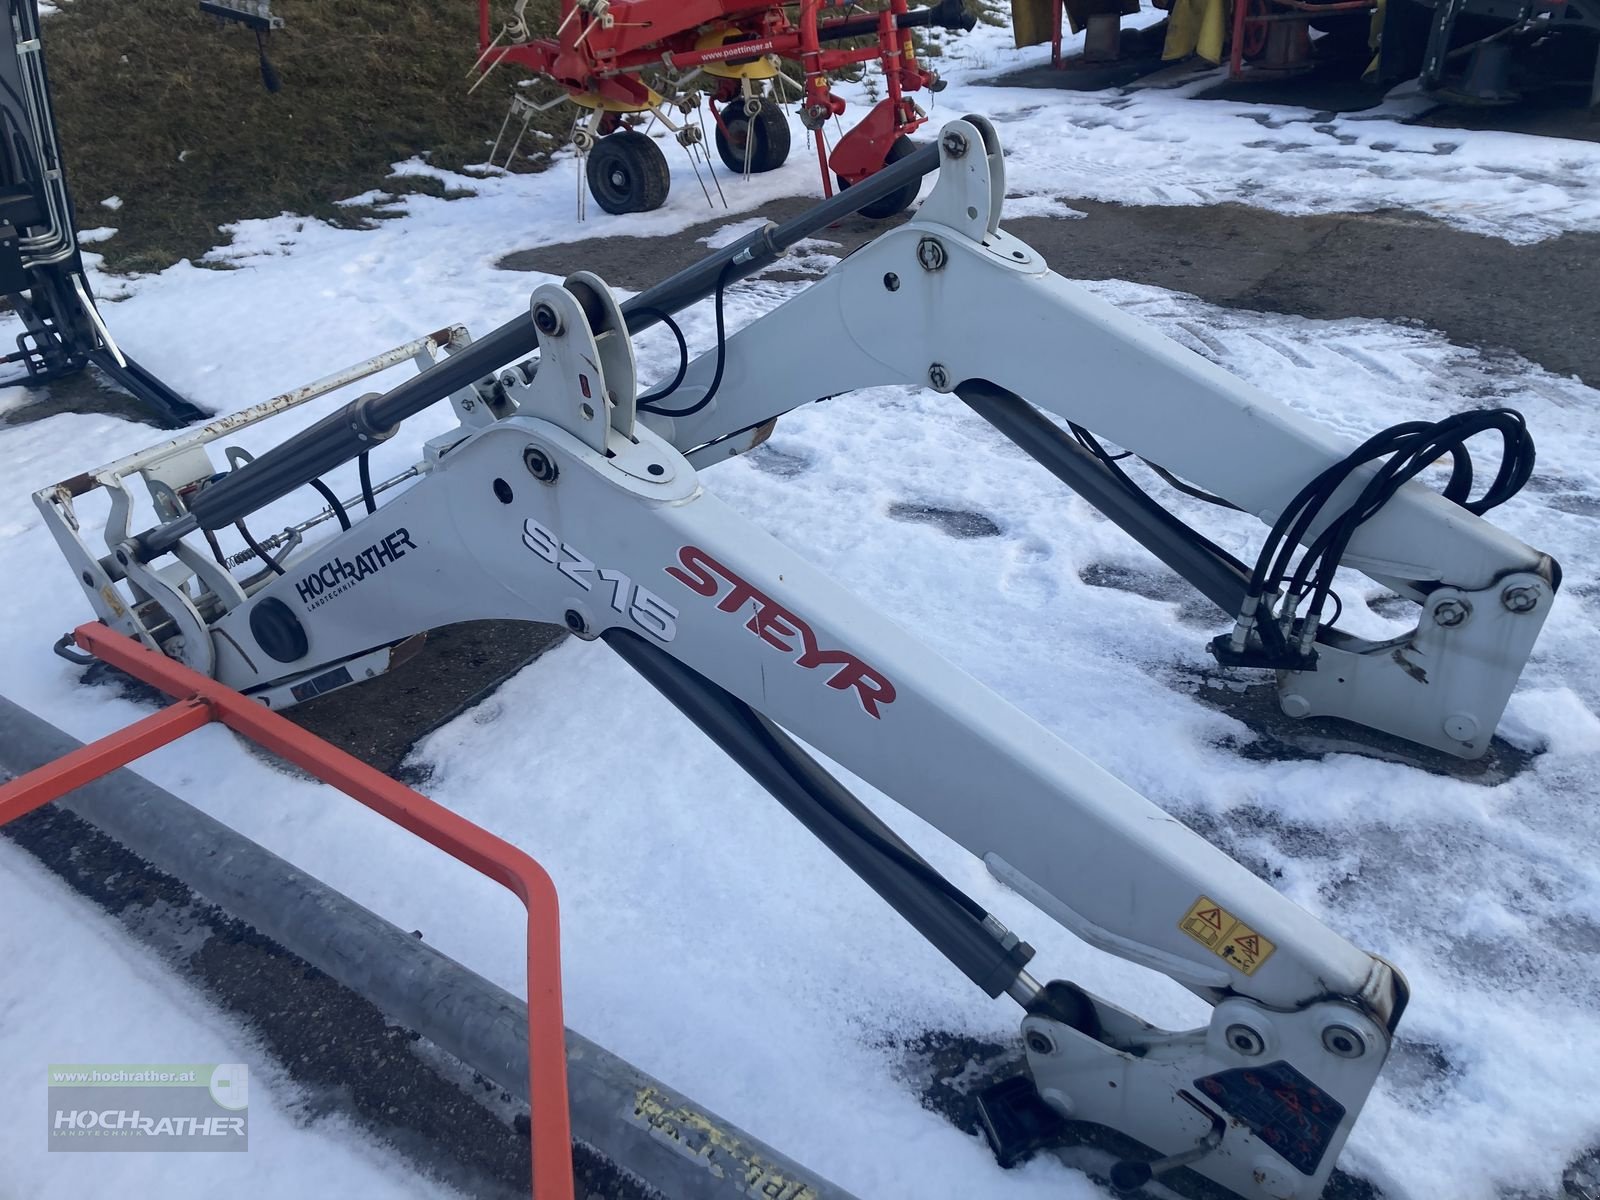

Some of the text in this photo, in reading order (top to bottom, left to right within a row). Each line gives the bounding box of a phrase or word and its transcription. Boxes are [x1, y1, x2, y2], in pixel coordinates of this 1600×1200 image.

[701, 41, 773, 61] www.poettinger.at
[295, 527, 418, 604] HOCHRATHER
[307, 580, 356, 612] LANDTECHNIK
[522, 518, 680, 643] SZ15
[664, 545, 897, 720] STEYR
